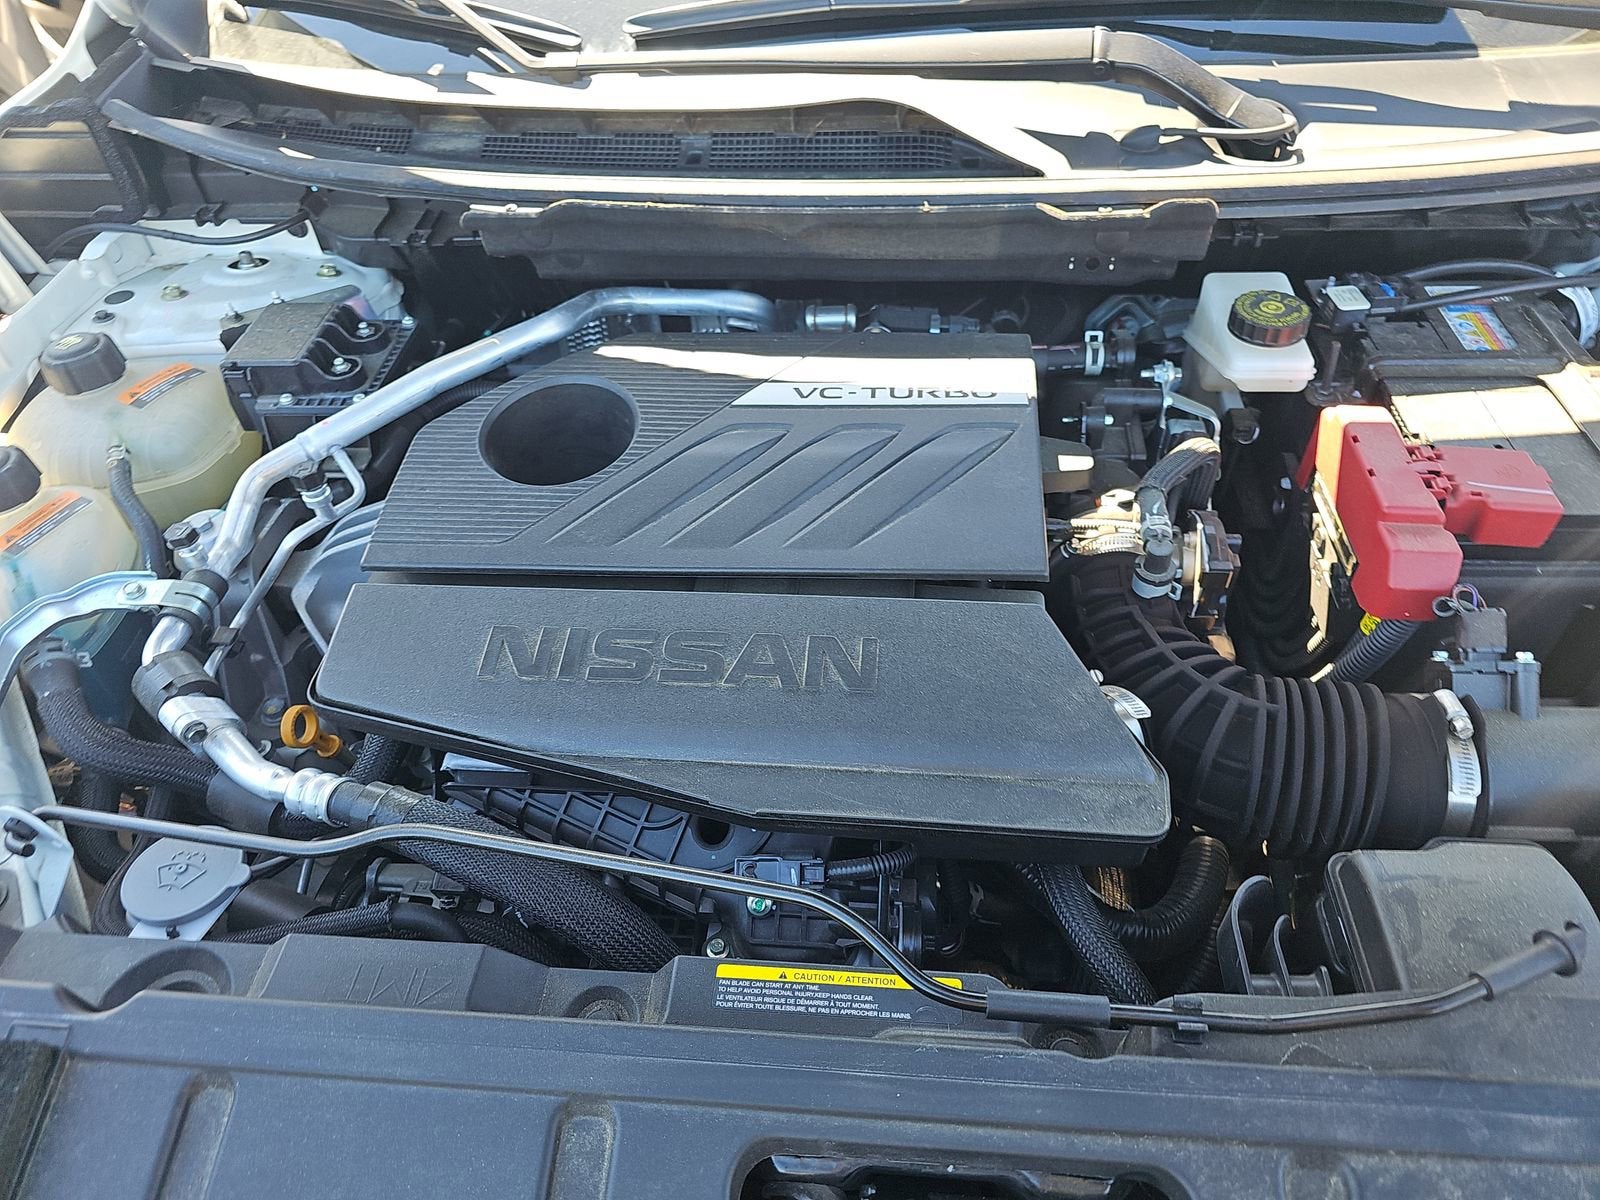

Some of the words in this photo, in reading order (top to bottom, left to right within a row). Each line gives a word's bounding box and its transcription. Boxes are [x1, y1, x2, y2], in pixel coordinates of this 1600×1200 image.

[792, 387, 998, 399] VC-TURBO
[477, 625, 880, 692] NISSAN
[731, 979, 750, 987] BLADE
[793, 972, 835, 982] CAUTION
[845, 975, 896, 986] ATTENTION
[762, 989, 793, 997] PERSONAL
[725, 994, 762, 1002] VENTILATEUR
[763, 996, 786, 1004] RISQUE
[796, 998, 829, 1007] DÉMARRER
[851, 1002, 880, 1010] MOMENT.
[733, 1001, 754, 1009] ÉVITER
[774, 1004, 807, 1012] BLESSURE,
[840, 1008, 878, 1017] APPROCHER
